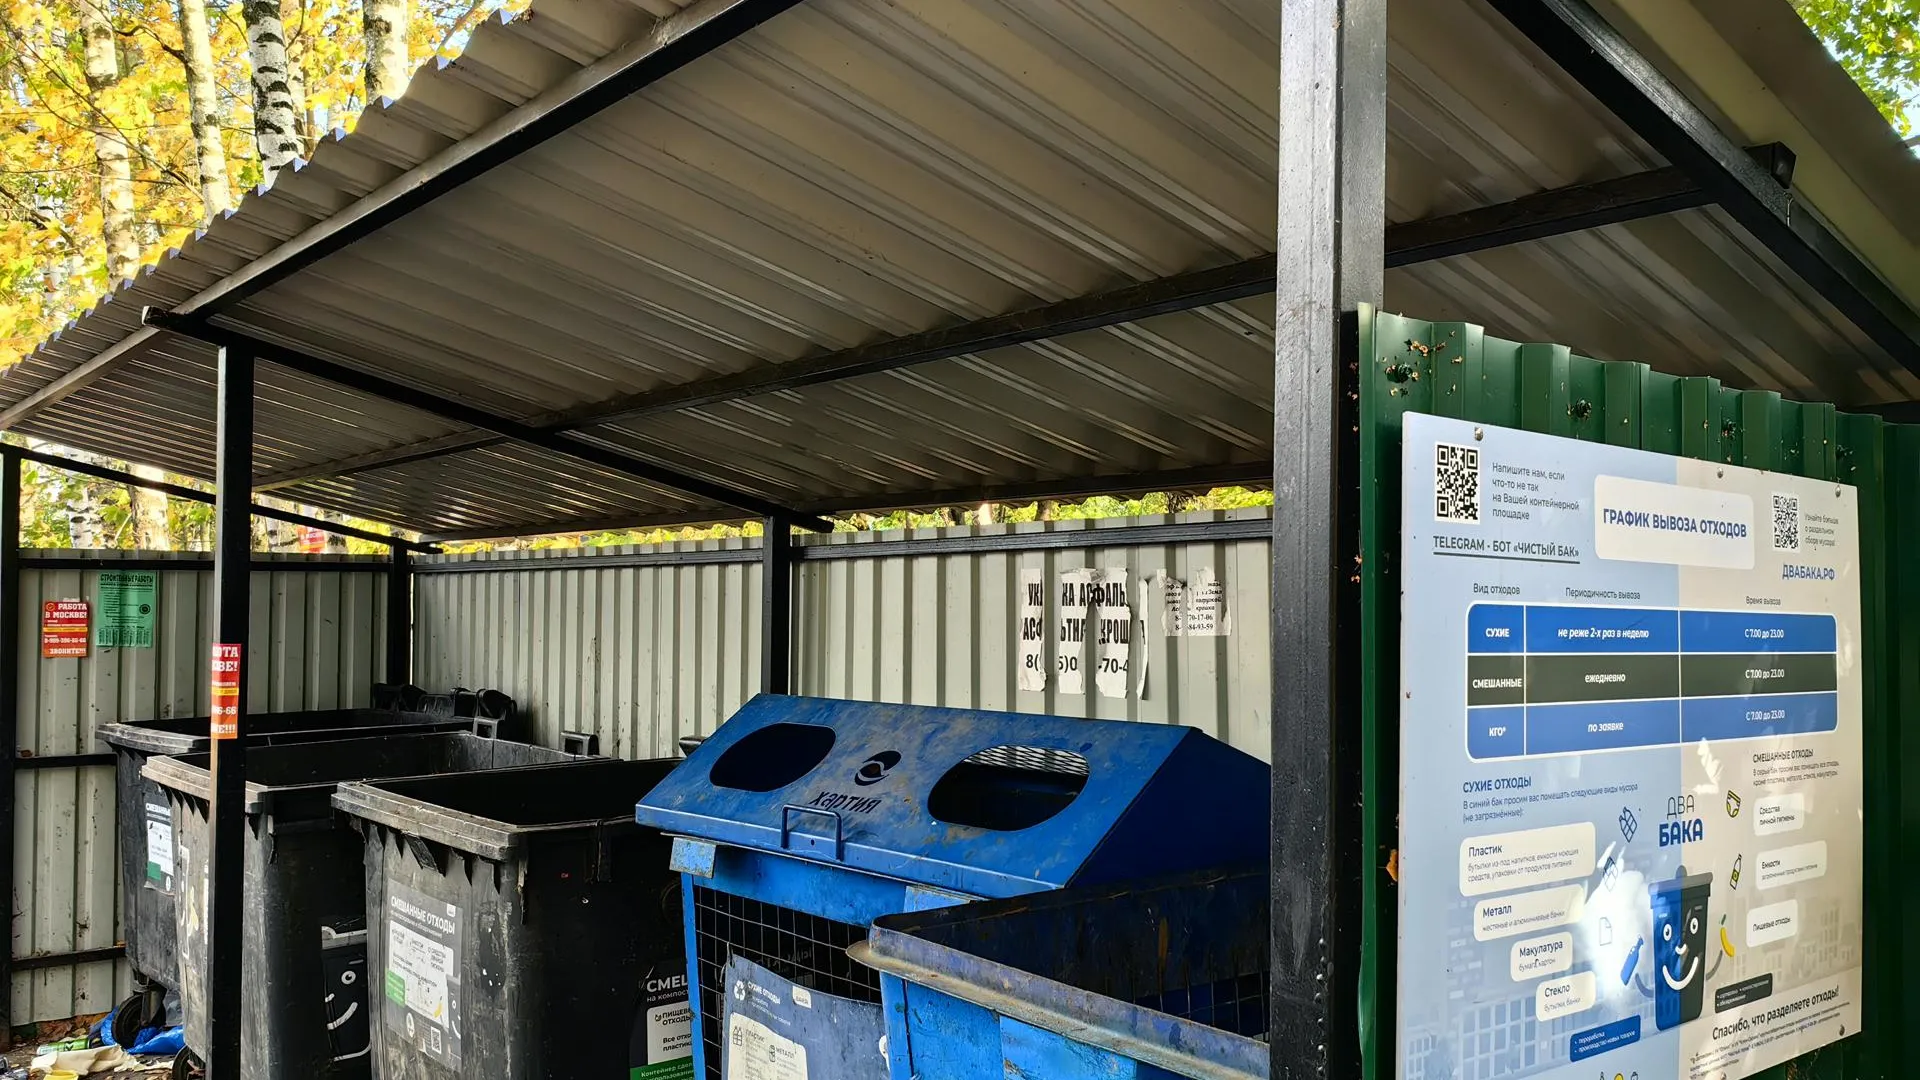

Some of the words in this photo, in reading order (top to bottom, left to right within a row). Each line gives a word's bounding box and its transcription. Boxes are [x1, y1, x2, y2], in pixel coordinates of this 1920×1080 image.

[1492, 462, 1530, 476] Напишите
[1532, 469, 1547, 479] нам,
[1549, 471, 1565, 480] если
[1492, 480, 1515, 489] что-то
[1517, 482, 1526, 490] не
[1527, 482, 1539, 491] так
[1492, 494, 1502, 502] на
[1504, 494, 1528, 505] Вашей
[1529, 498, 1579, 512] контейнерной
[1492, 508, 1530, 520] площадке
[1603, 508, 1650, 528] ГРАФИК
[1652, 513, 1697, 533] ВЫВОЗА
[1700, 519, 1747, 539] ОТХОДОВ
[1433, 535, 1485, 550] TELEGRAM
[1492, 540, 1511, 553] БОТ
[1513, 541, 1556, 556] «ЧИСТЫЙ
[1557, 545, 1579, 557] БАК»
[1782, 564, 1835, 580] ДВАБАКА.РФ
[1473, 583, 1489, 594] Вид
[1490, 585, 1521, 595] отходов
[1565, 587, 1617, 599] Периодичность
[1618, 591, 1641, 600] вывоза
[1746, 596, 1762, 605] Время
[45, 611, 51, 619] В
[53, 611, 87, 619] МОСКВЕ!
[1485, 628, 1510, 638] СУХИЕ
[1558, 628, 1568, 637] не
[1569, 629, 1589, 640] реже
[1590, 628, 1601, 638] 2-х
[1602, 629, 1616, 640] раз
[1616, 630, 1621, 638] в
[1622, 630, 1650, 640] неделю
[1750, 629, 1762, 638] 7.00
[1762, 630, 1770, 639] до
[1770, 629, 1784, 638] 23.00
[1585, 673, 1626, 683] ежедневно
[1751, 670, 1762, 678] 7.00
[1763, 670, 1770, 679] до
[1770, 669, 1785, 678] 23.00
[1472, 678, 1523, 689] СМЕШАННЫЕ
[1751, 711, 1763, 721] 7.00
[1763, 711, 1771, 720] до
[1771, 710, 1785, 719] 23.00
[1588, 723, 1598, 732] по
[1599, 722, 1624, 732] заявке
[1753, 751, 1791, 763] СМЕШАННЫЕ
[1791, 749, 1814, 759] ОТХОДЫ
[1463, 780, 1493, 793] СУХИЕ
[1494, 775, 1532, 790] ОТХОДЫ
[1463, 801, 1468, 809] В
[1469, 797, 1490, 809] синий
[1491, 796, 1503, 807] бак
[1503, 796, 1528, 807] просим
[1529, 794, 1540, 803] вас
[1541, 791, 1570, 801] помещать
[1571, 789, 1603, 799] следующие
[1604, 787, 1618, 795] виды
[1619, 784, 1638, 793] мусора
[1667, 795, 1695, 819] ДВА
[1659, 818, 1703, 847] БАКА
[1469, 845, 1502, 857] Пластик
[1468, 862, 1491, 873] бутылки
[391, 896, 427, 922] СМЕШАННЫЕ
[427, 913, 456, 935] ОТХОДЫ
[1483, 905, 1512, 918] Металл
[1550, 910, 1565, 919] банки
[1753, 918, 1775, 932] Пищевые
[1519, 941, 1563, 957] Макулатура
[647, 995, 656, 1003] на
[658, 989, 689, 1001] компост
[1545, 984, 1570, 998] Стекло
[662, 1008, 691, 1019] ПИЩЕВ
[1712, 1017, 1750, 1040] Спасибо,
[1751, 1013, 1766, 1026] что
[1767, 998, 1810, 1024] разделяете
[1811, 984, 1839, 1005] отходы!
[676, 1033, 692, 1041] отхо
[663, 1041, 692, 1052] пластик
[641, 1066, 677, 1078] Контейнер
[677, 1062, 692, 1070] сдел
